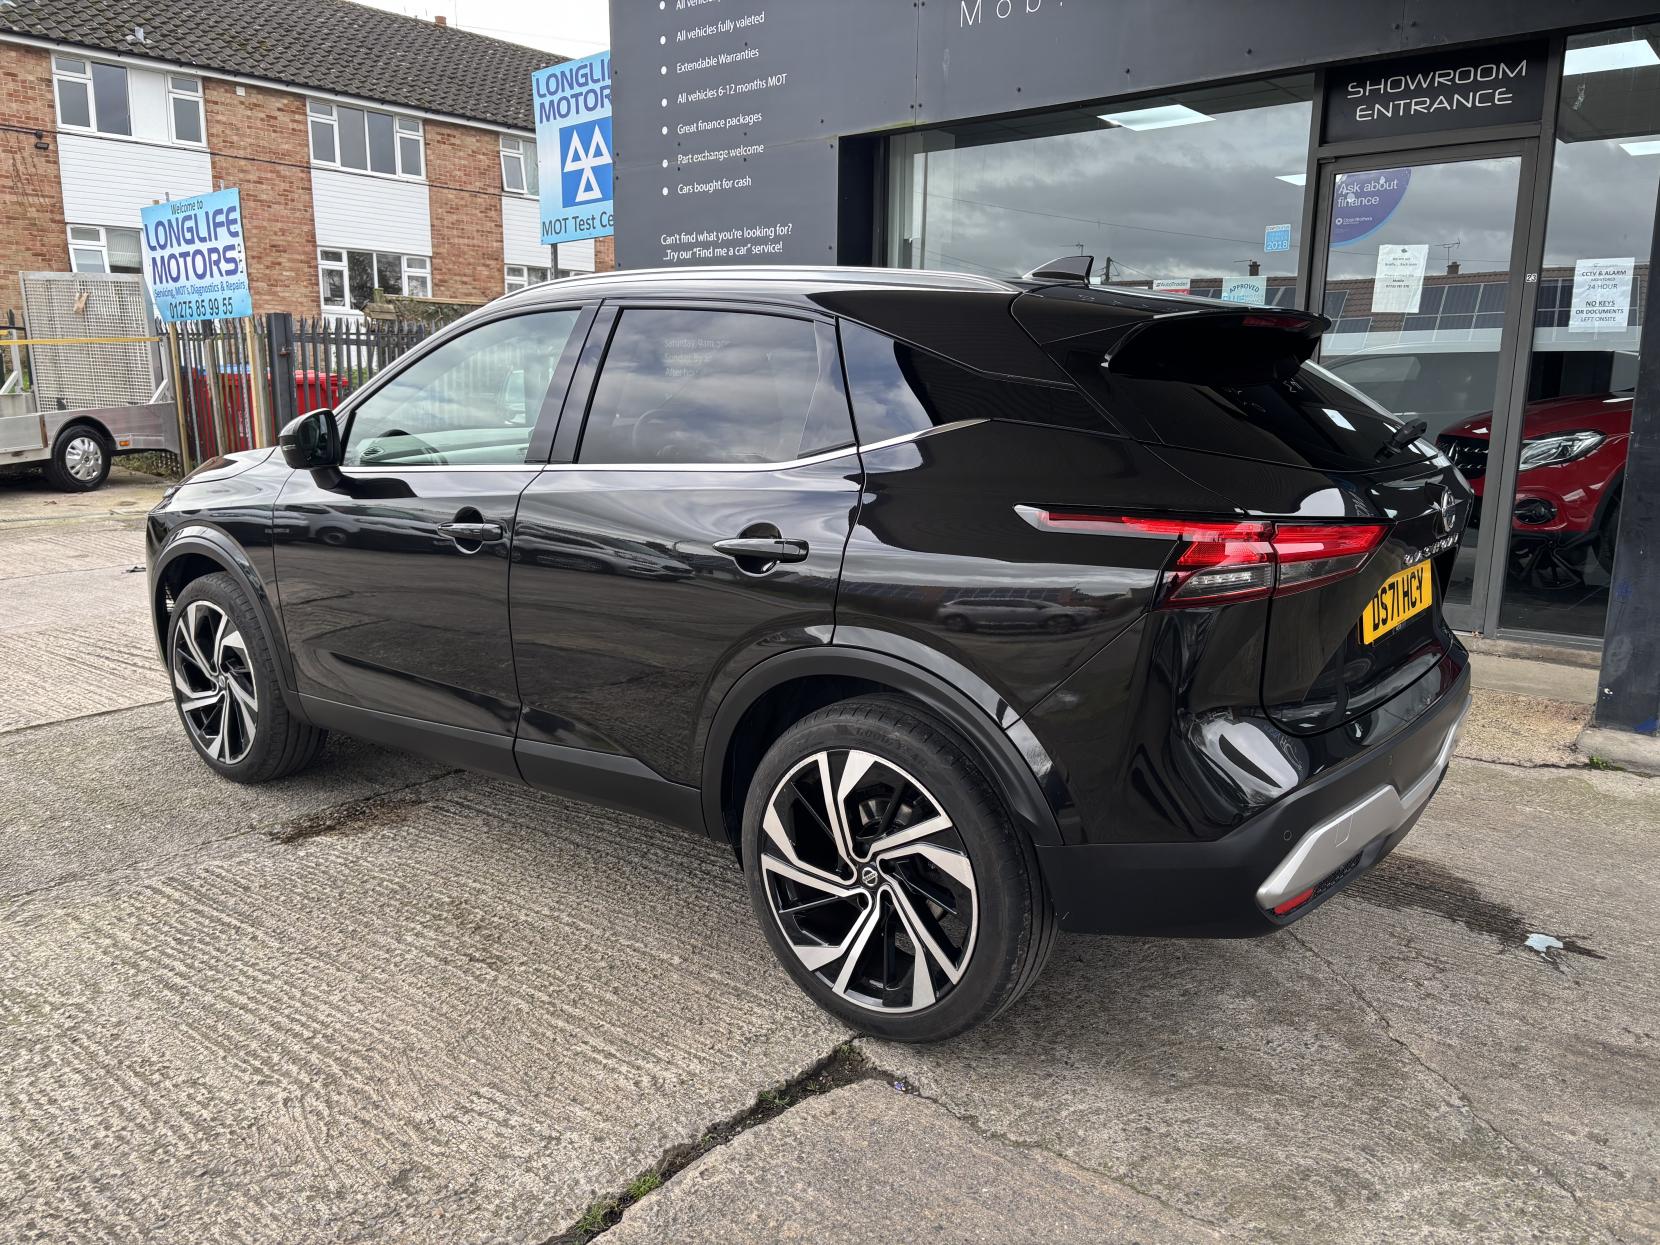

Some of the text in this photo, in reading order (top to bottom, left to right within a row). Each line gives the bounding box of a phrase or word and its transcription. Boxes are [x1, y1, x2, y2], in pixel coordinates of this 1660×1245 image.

[677, 11, 765, 42] All vehicles fully valeted
[676, 48, 760, 73] Extendable Warranties
[677, 73, 788, 104] All vehicles 6-12 months MOT
[1347, 59, 1527, 99] SHOWROOM
[1356, 88, 1513, 121] ENTRANCE
[677, 112, 763, 134] Great finance packages
[677, 144, 765, 165] Part exchange welcome
[677, 175, 752, 194] Cars bought for cash
[1338, 178, 1398, 195] Ask about
[171, 199, 204, 215] Welcome to
[1337, 196, 1380, 208] finance
[144, 205, 240, 252] LONGLIFE
[542, 217, 569, 237] MOT
[572, 213, 596, 233] Test
[660, 223, 793, 245] Can't find what you're looking for?
[679, 250, 693, 260] our
[714, 248, 728, 257] me
[728, 247, 734, 256] a
[751, 241, 783, 254] service!
[1266, 240, 1288, 250] 2018
[152, 243, 239, 286] MOTORS
[1230, 283, 1260, 293] APPROVED
[1526, 273, 1537, 282] 23
[190, 281, 220, 297] Diagnostics
[169, 296, 233, 319] 01275 85 99 55
[1372, 566, 1425, 633] DS71 HCY
